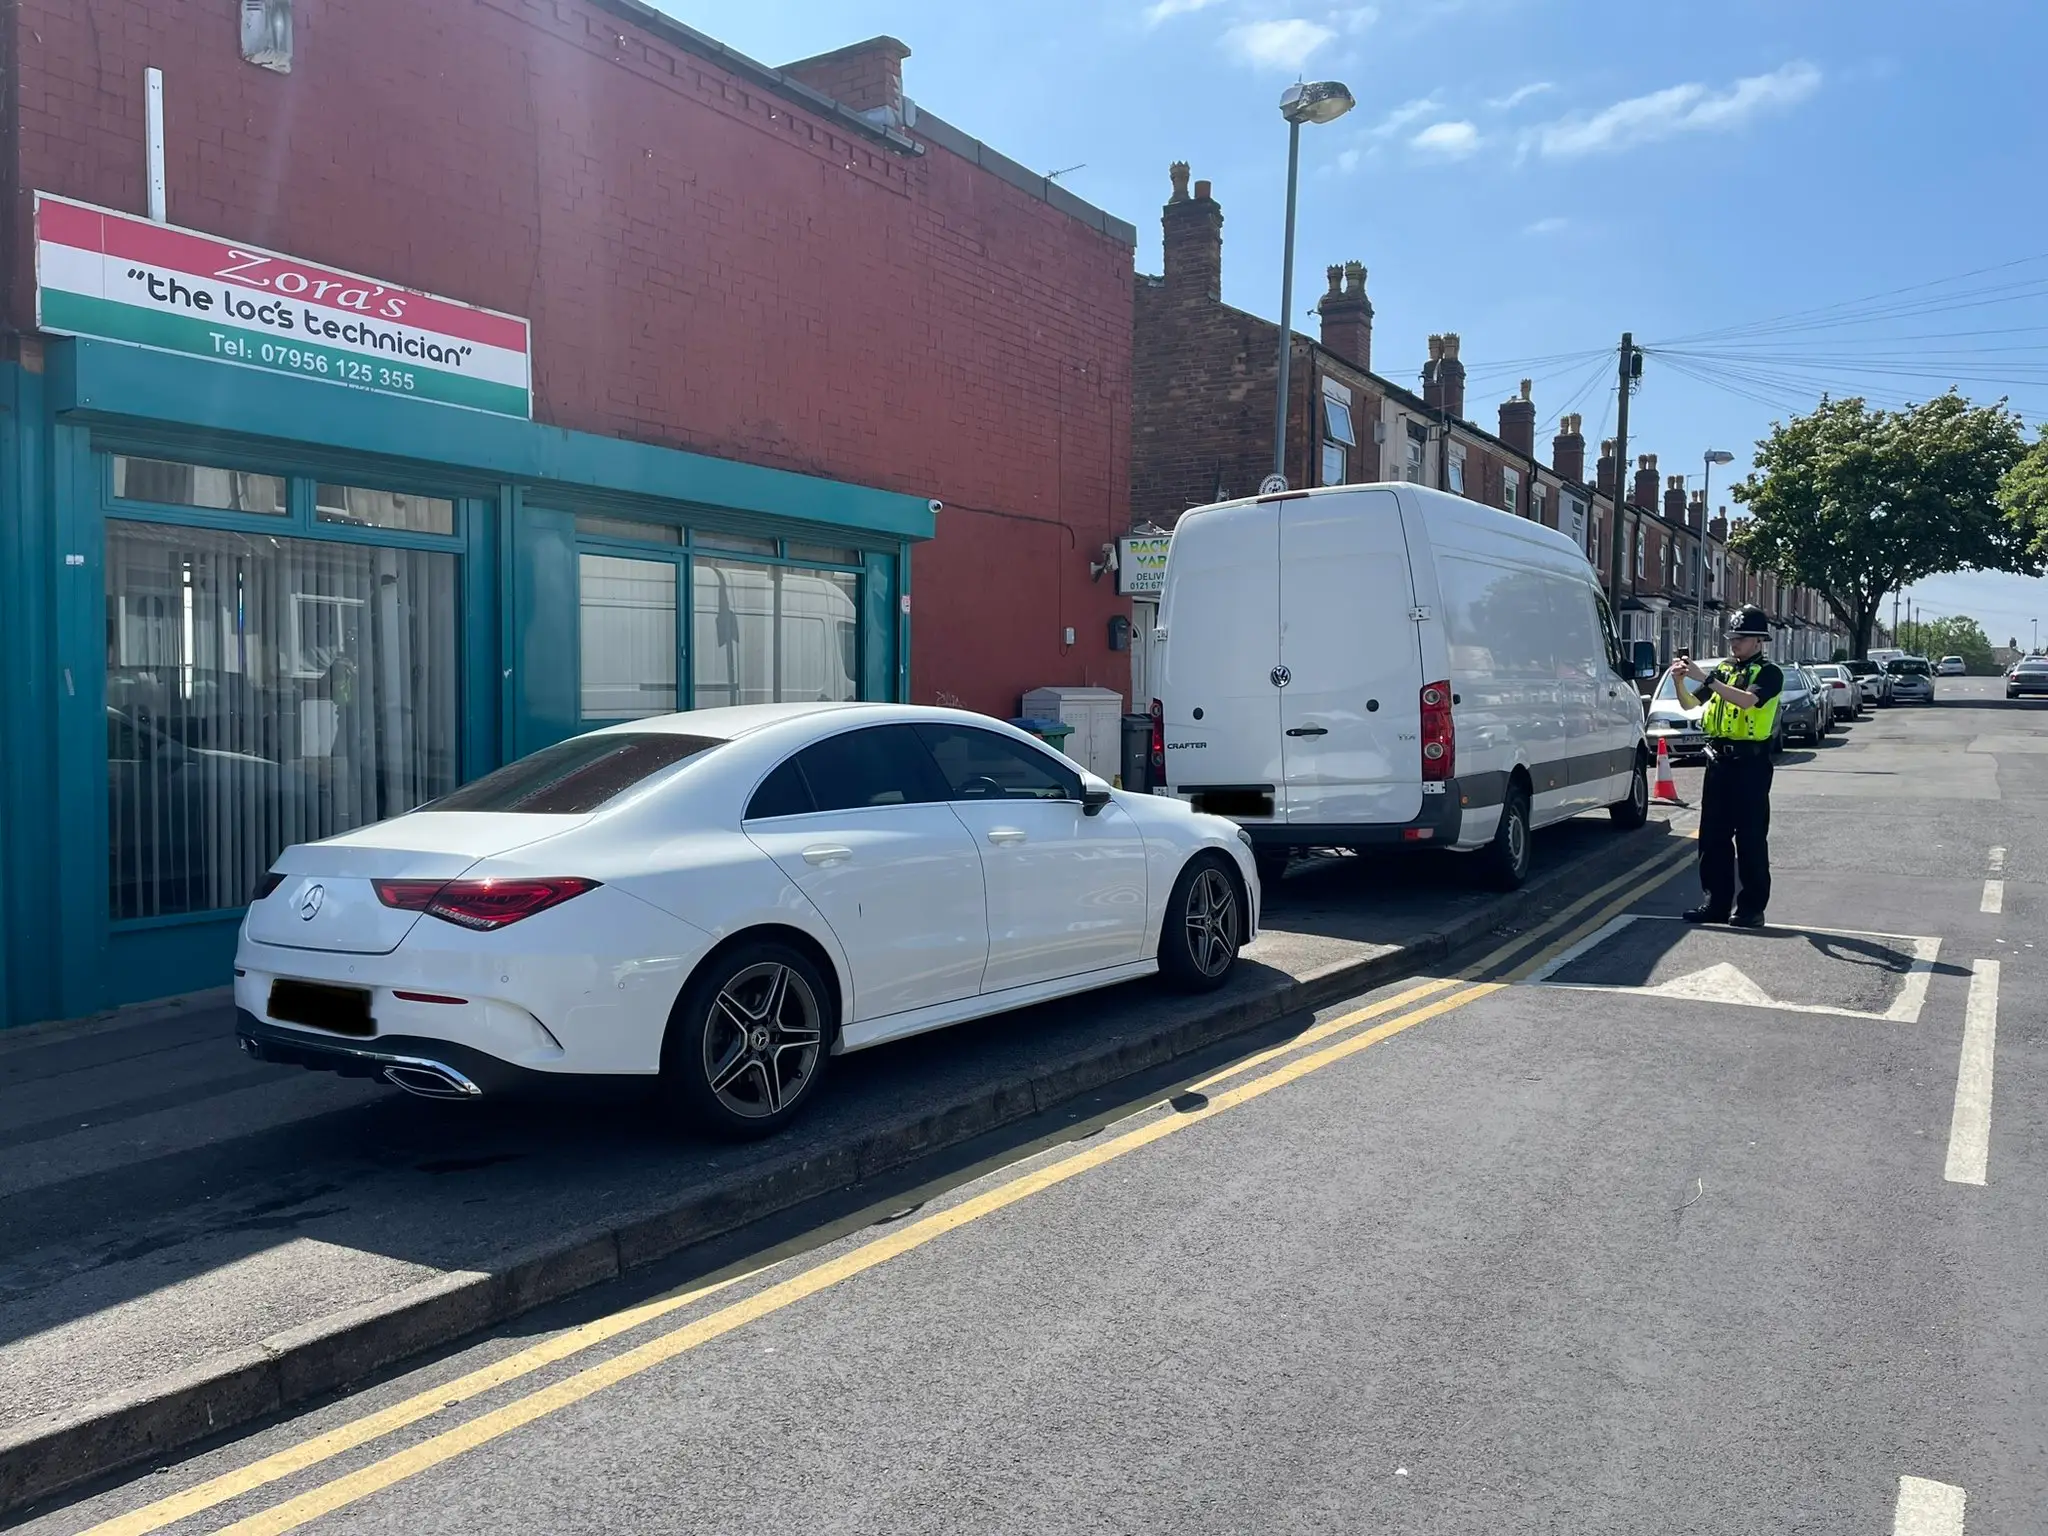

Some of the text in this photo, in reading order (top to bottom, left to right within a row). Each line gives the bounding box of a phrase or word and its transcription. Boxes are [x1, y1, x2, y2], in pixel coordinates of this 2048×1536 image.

[214, 250, 407, 318] Zora's
[224, 291, 294, 330] loc's
[209, 332, 415, 391] Tel: 07956 125 355
[1130, 582, 1149, 590] 0121
